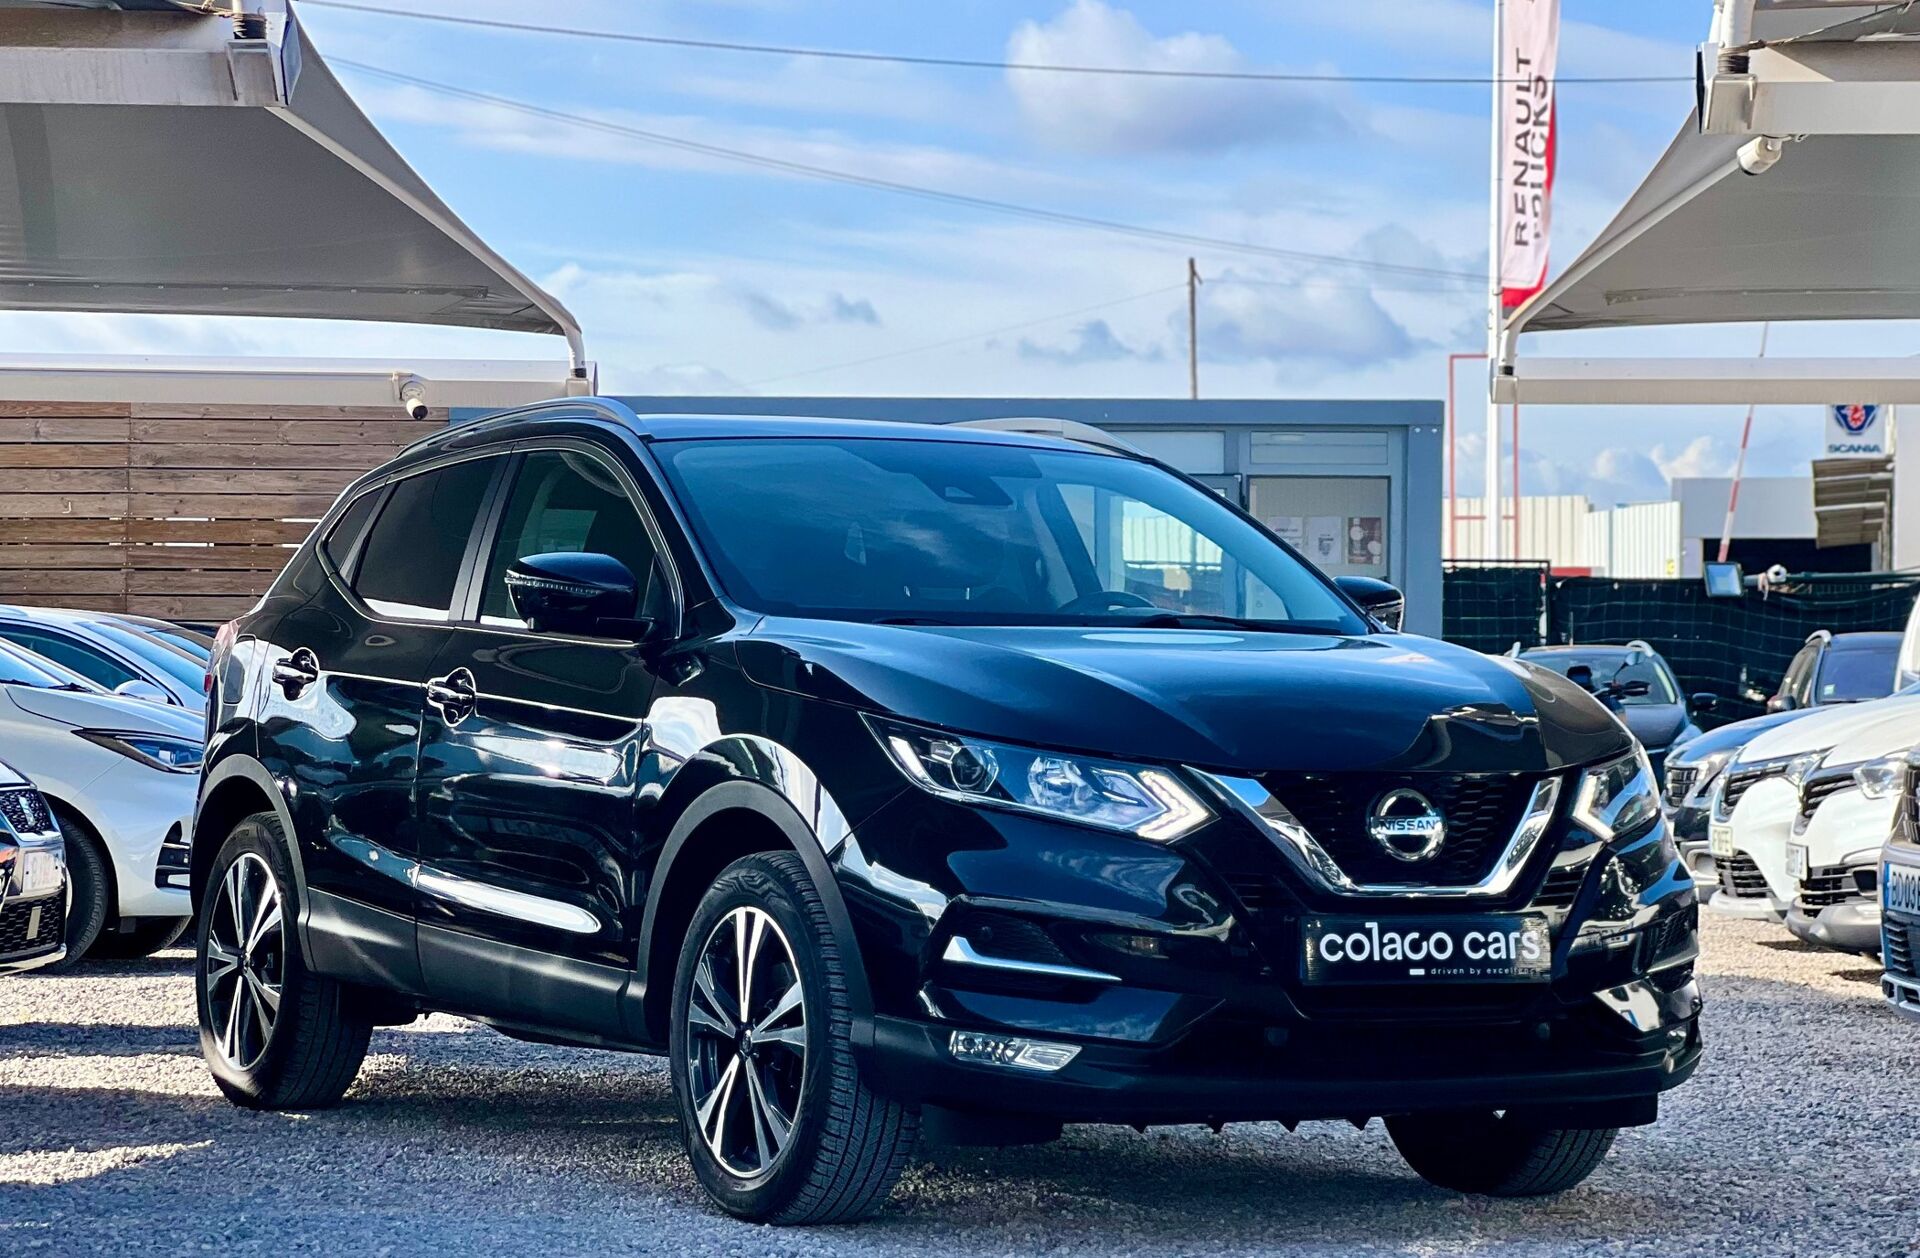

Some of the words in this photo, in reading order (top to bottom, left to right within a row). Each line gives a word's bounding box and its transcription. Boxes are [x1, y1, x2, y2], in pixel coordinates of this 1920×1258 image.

[1513, 47, 1532, 247] RENAULT
[1828, 443, 1881, 453] SCANIA
[1380, 819, 1435, 831] NISSAN
[1463, 931, 1541, 960] cars
[1430, 967, 1465, 975] driven
[1469, 967, 1481, 976] by
